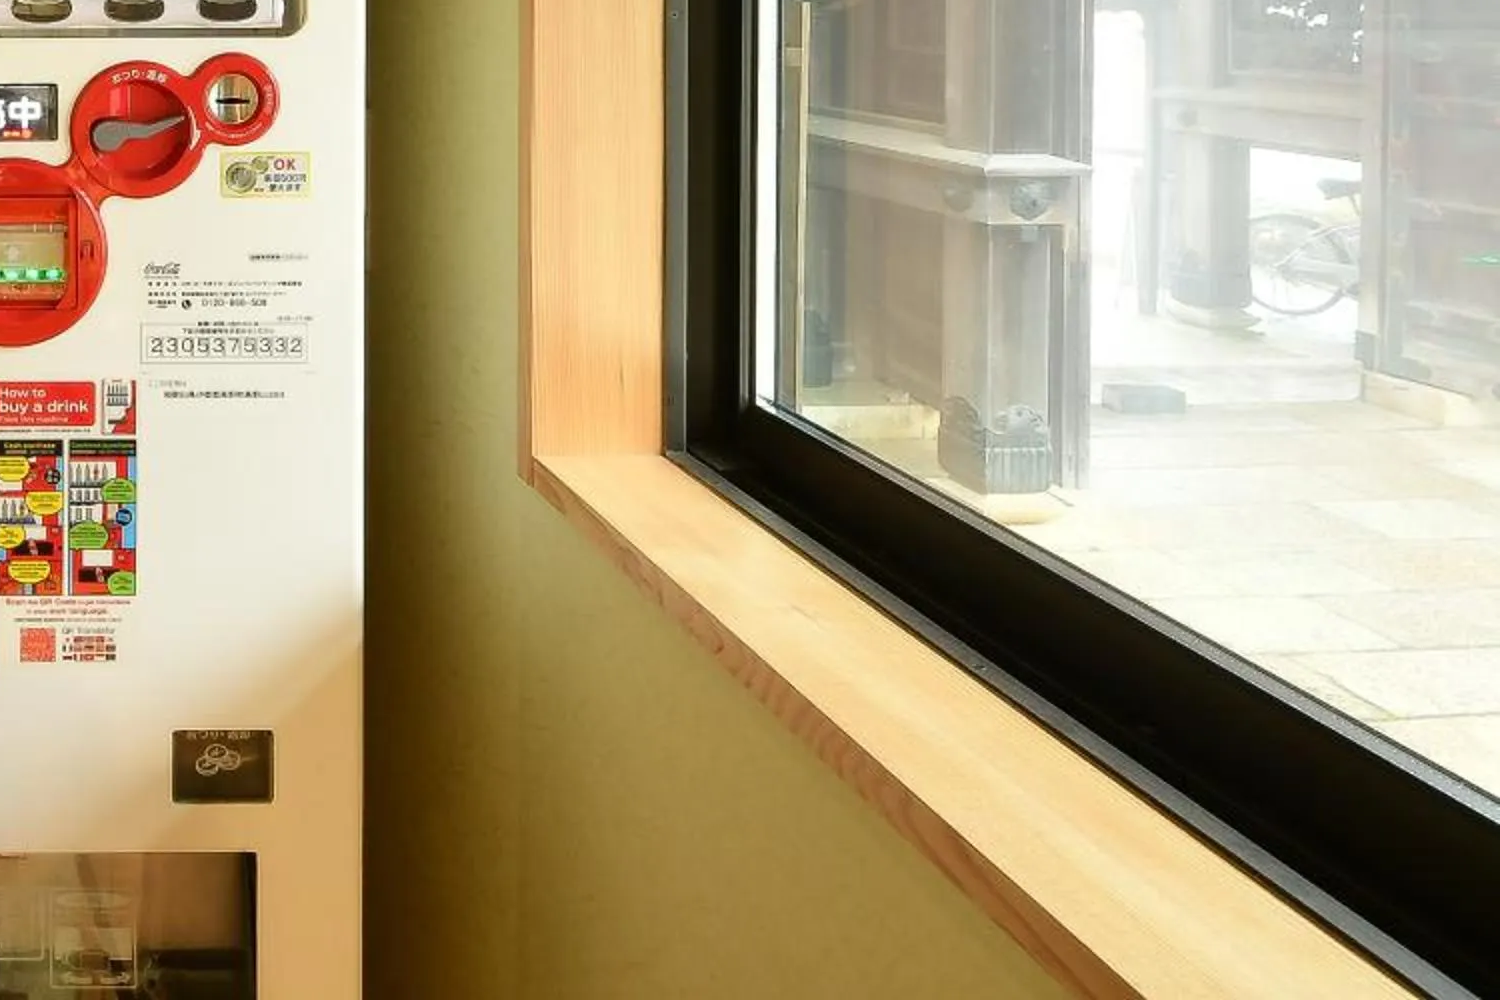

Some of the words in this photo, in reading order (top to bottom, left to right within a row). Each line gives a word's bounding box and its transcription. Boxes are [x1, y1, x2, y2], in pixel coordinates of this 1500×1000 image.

[274, 158, 296, 170] OK
[150, 337, 302, 353] 2305375332
[0, 388, 28, 398] How
[31, 388, 47, 398] to
[0, 401, 29, 414] buy
[33, 403, 43, 412] a
[47, 400, 89, 413] drink
